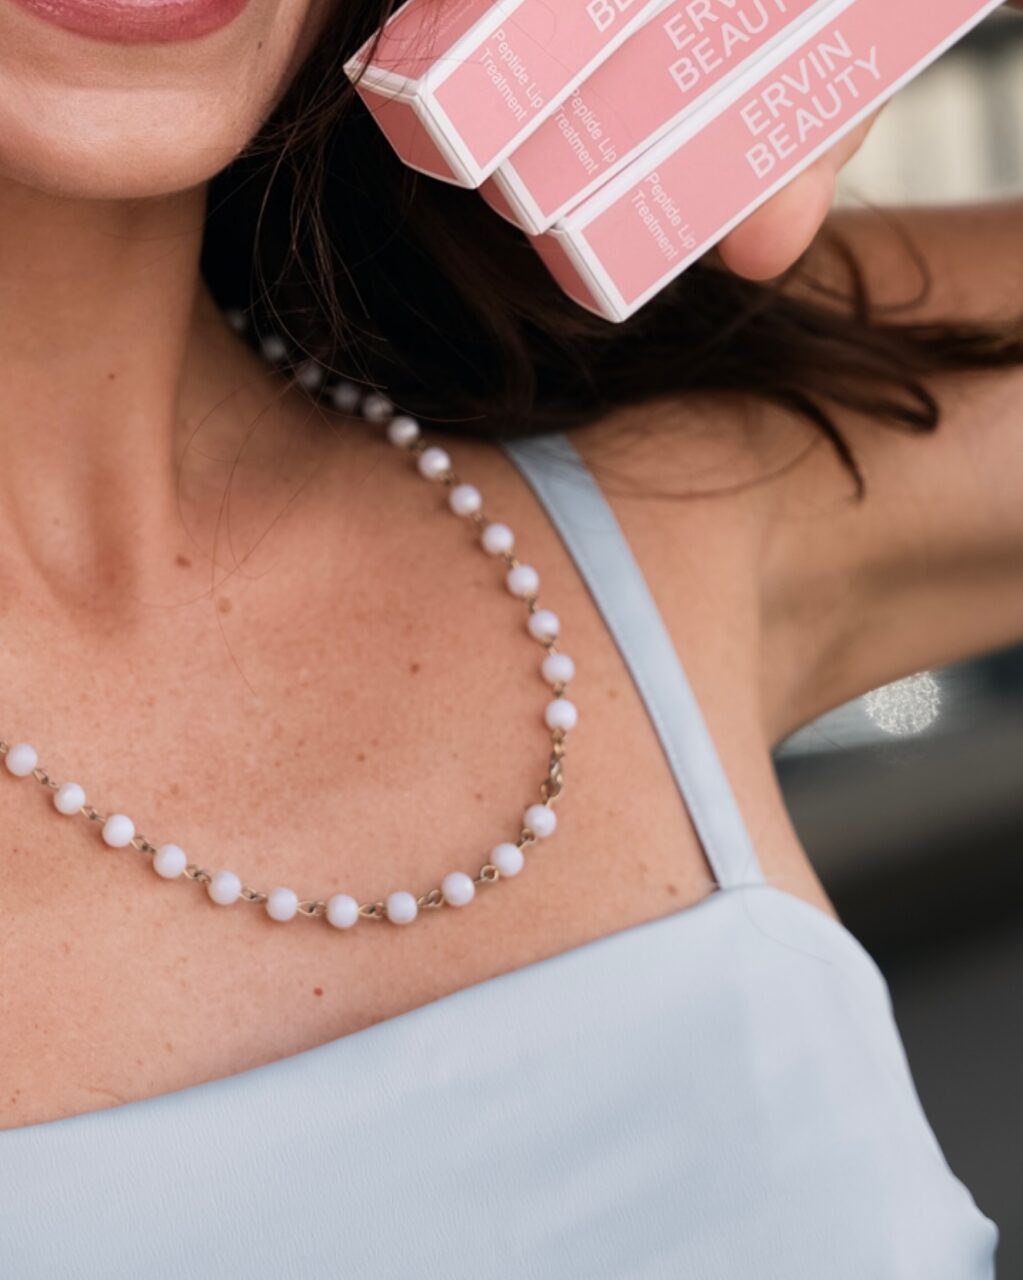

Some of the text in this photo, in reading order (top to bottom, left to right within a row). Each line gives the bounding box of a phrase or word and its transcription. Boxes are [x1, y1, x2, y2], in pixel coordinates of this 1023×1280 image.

[479, 48, 529, 122] Treatment
[491, 28, 544, 109] Peptide Lip
[739, 29, 853, 137] ERVIN
[597, 137, 617, 163] Lip
[744, 45, 881, 180] BEAUTY
[631, 188, 679, 261] Treatment
[644, 171, 696, 250] Peptide Lip
